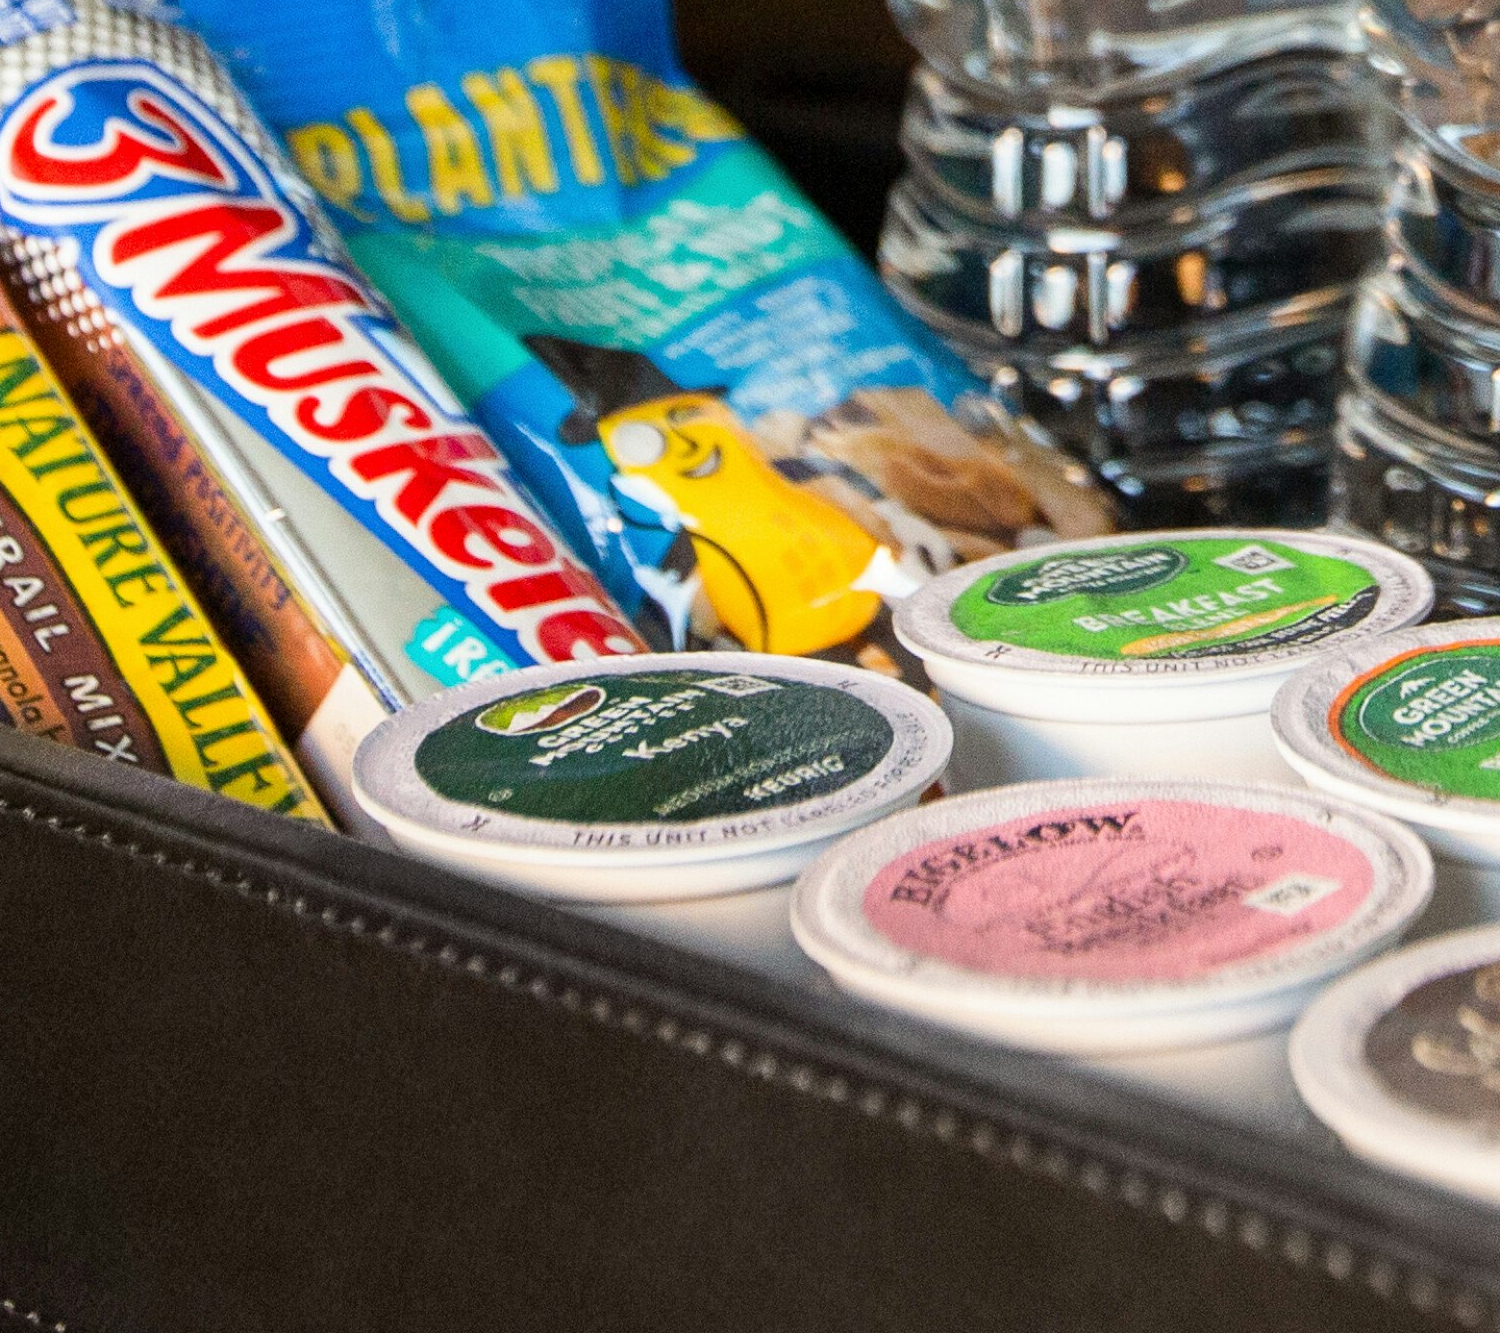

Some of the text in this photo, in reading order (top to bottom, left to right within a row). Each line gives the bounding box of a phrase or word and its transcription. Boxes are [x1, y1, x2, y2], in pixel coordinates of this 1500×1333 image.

[4, 85, 232, 196] 3
[1071, 575, 1288, 635] BREAKFAST
[1145, 659, 1202, 674] UNIT
[63, 672, 140, 765] MIX
[1391, 668, 1490, 727] GREEN
[621, 713, 750, 763] Kenya
[742, 753, 848, 804] KEURIG
[572, 829, 633, 849] THIS
[644, 828, 708, 849] UNIT
[721, 818, 774, 844] NOT
